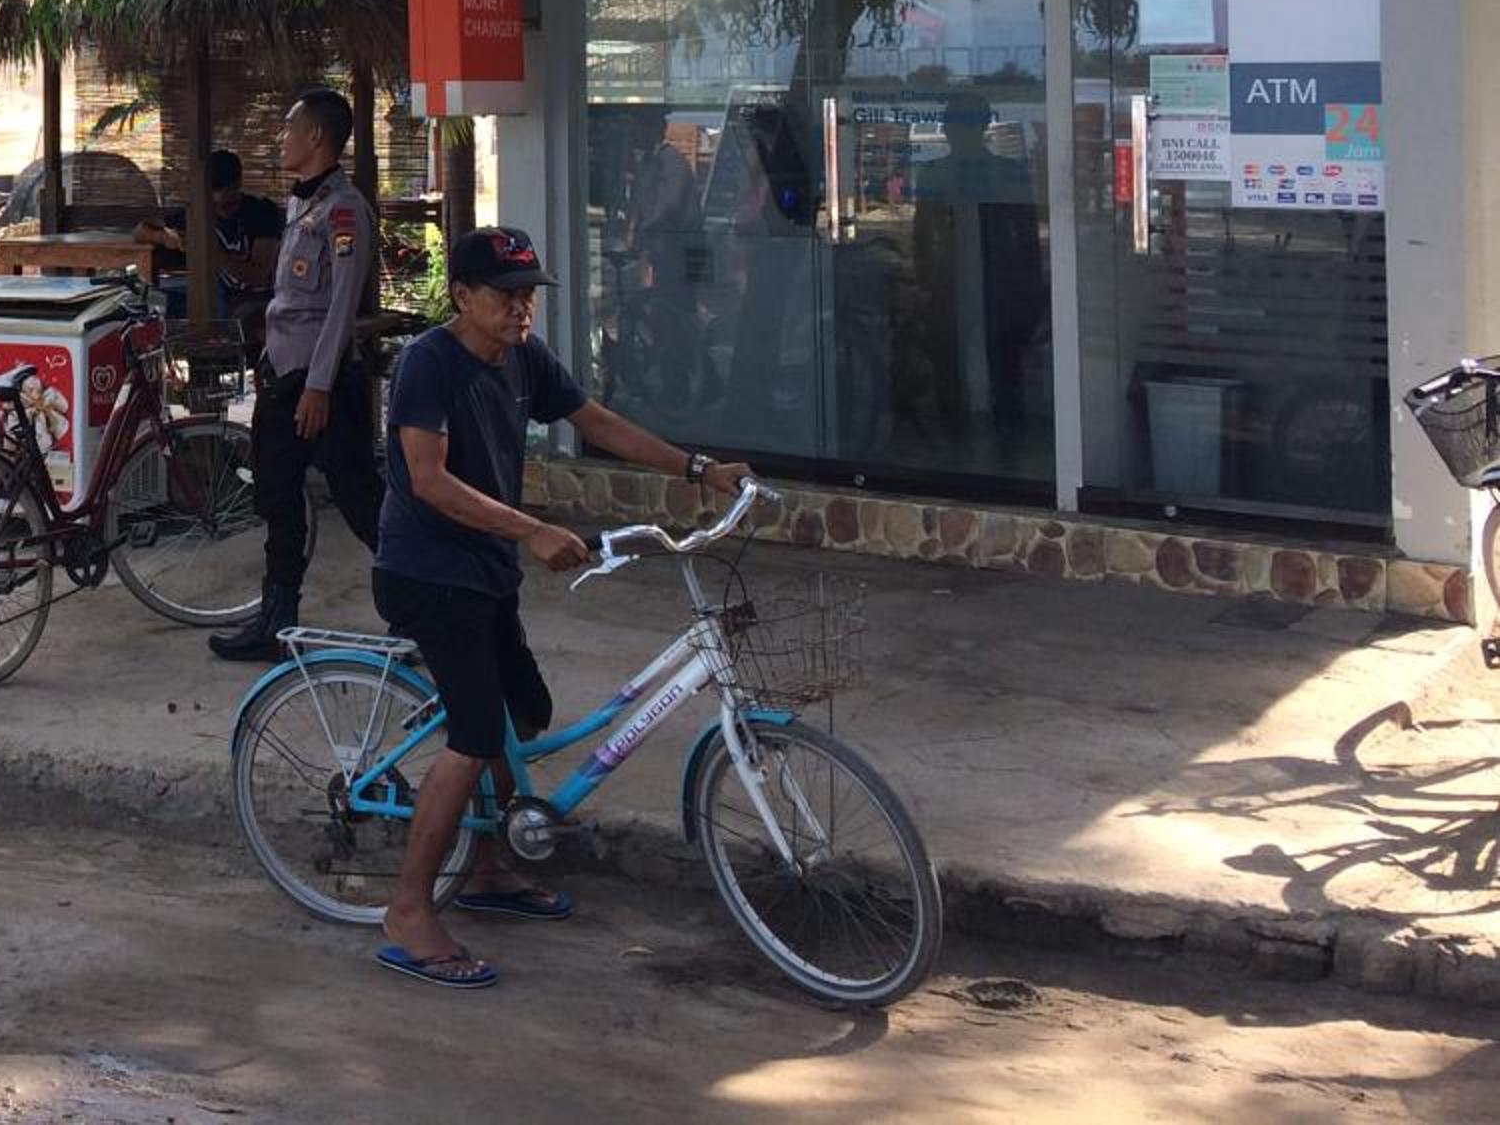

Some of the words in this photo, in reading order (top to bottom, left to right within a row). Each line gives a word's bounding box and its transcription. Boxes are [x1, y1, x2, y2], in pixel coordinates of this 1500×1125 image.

[1246, 78, 1318, 105] ATM
[1325, 104, 1380, 142] 24
[1161, 138, 1185, 149] BNI
[1186, 138, 1221, 149] CALL
[1345, 142, 1381, 158] Jam
